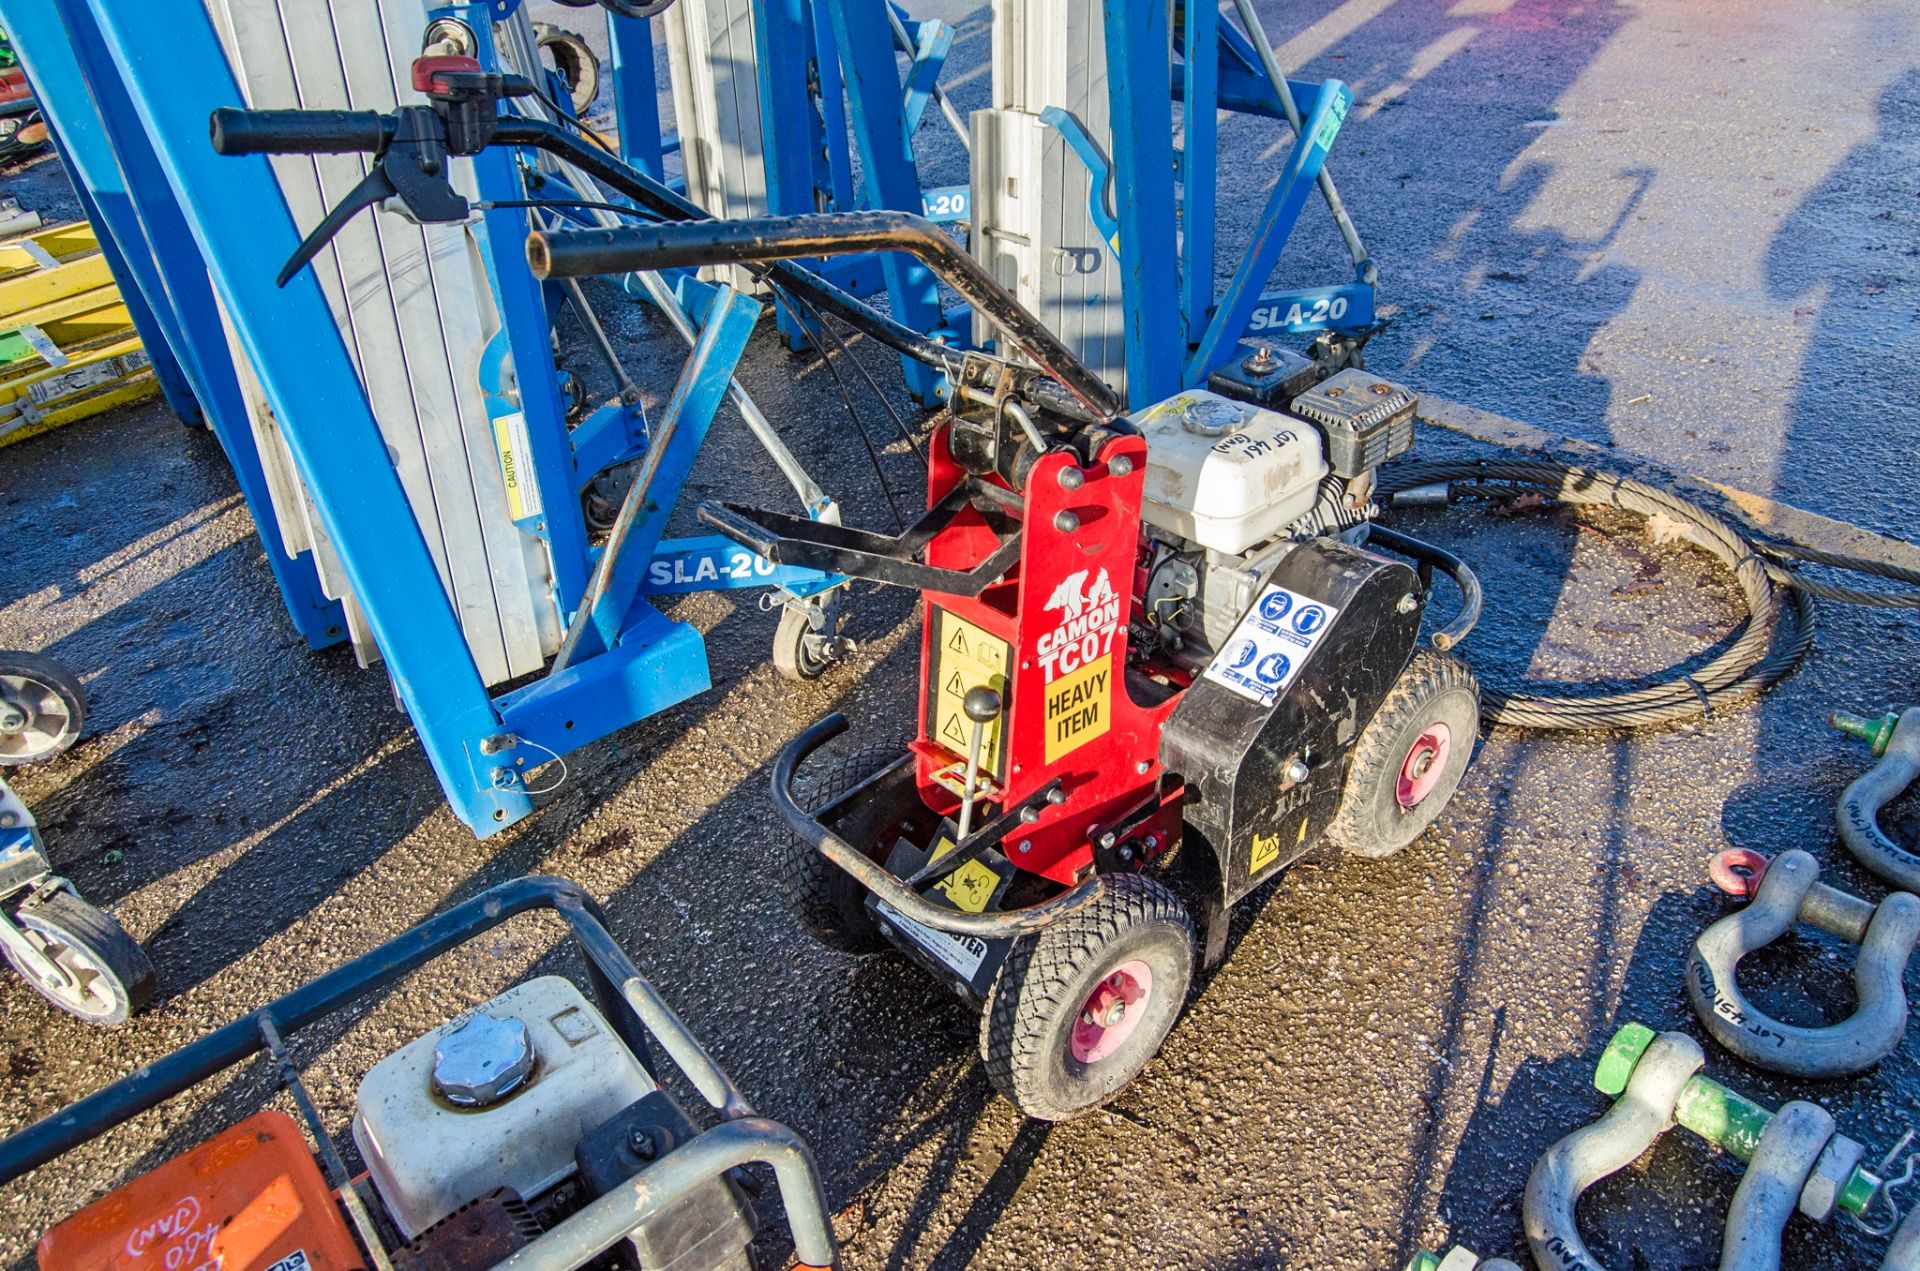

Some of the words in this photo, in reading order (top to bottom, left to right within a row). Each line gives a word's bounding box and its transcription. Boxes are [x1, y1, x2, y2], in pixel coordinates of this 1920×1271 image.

[1249, 298, 1347, 330] SLA-20
[1211, 433, 1251, 454] (JAN)
[1243, 440, 1272, 459] 461
[1272, 430, 1298, 448] LOT
[503, 450, 517, 489] CAUTION
[649, 553, 776, 585] SLA-20
[1037, 600, 1119, 656] CAMON
[1038, 621, 1118, 685] TC07
[1049, 670, 1107, 720] HEAVY
[1057, 702, 1098, 743] ITEM
[126, 1195, 201, 1258] (JAN)
